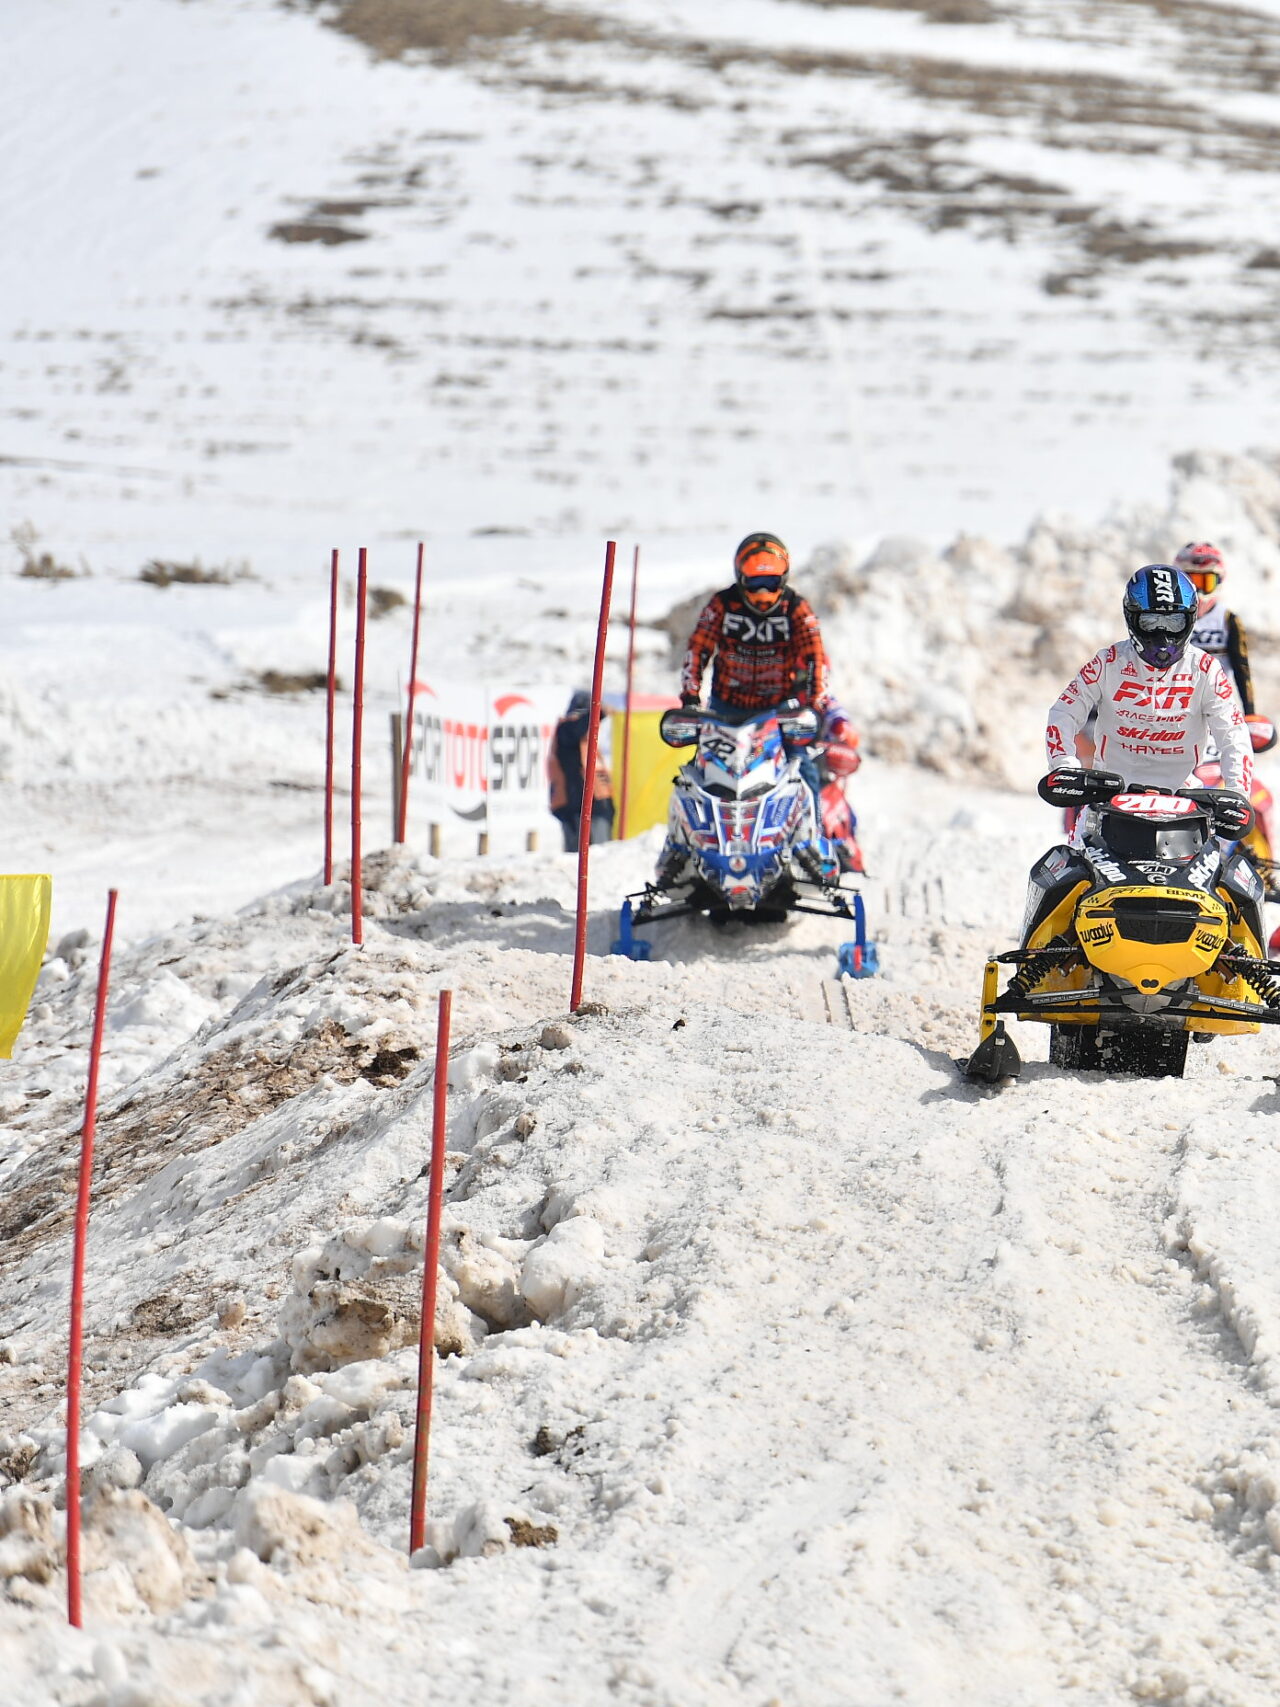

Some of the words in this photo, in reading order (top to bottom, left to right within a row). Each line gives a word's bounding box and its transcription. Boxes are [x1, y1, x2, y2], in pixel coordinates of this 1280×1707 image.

[1152, 569, 1175, 603] FXR
[723, 612, 790, 642] FXR
[1113, 681, 1195, 710] FXR
[1116, 795, 1194, 812] 200
